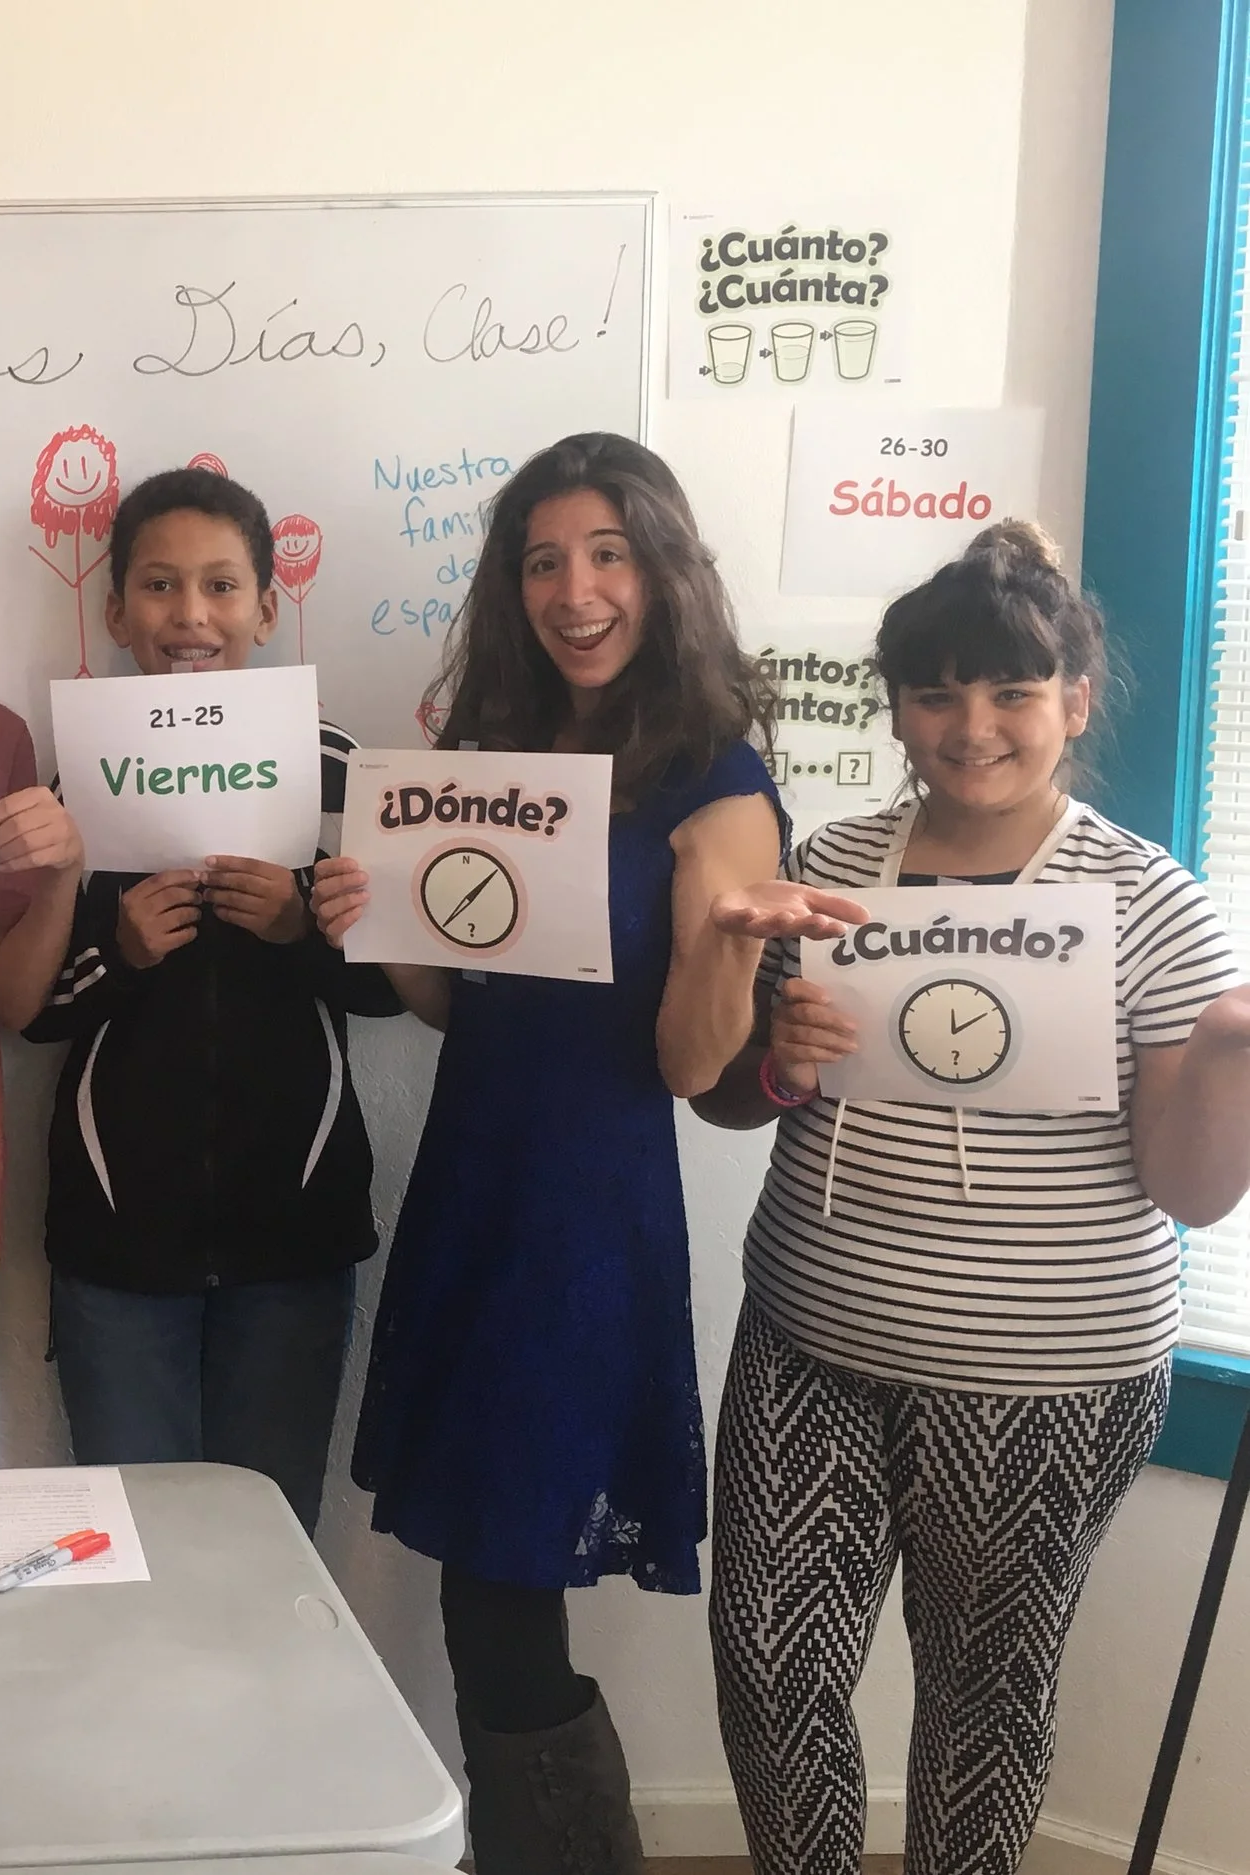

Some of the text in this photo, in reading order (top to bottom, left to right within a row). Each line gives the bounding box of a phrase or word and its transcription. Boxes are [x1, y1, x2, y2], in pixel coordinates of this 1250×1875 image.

[700, 224, 889, 272] ¿Cuánto?
[698, 267, 889, 314] ¿Cuánta?
[880, 437, 948, 458] 26-30
[375, 448, 514, 492] Nuestra
[829, 477, 992, 521] Sábado
[400, 496, 488, 547] famil
[437, 554, 478, 584] de
[372, 598, 453, 637] espa
[753, 647, 879, 690] ántos?
[150, 705, 224, 728] 21-25
[777, 692, 879, 730] ntas?
[100, 757, 278, 796] Viernes
[380, 782, 568, 836] ¿Dónde?
[462, 856, 470, 865] N
[831, 915, 1084, 967] ¿Cuándo?
